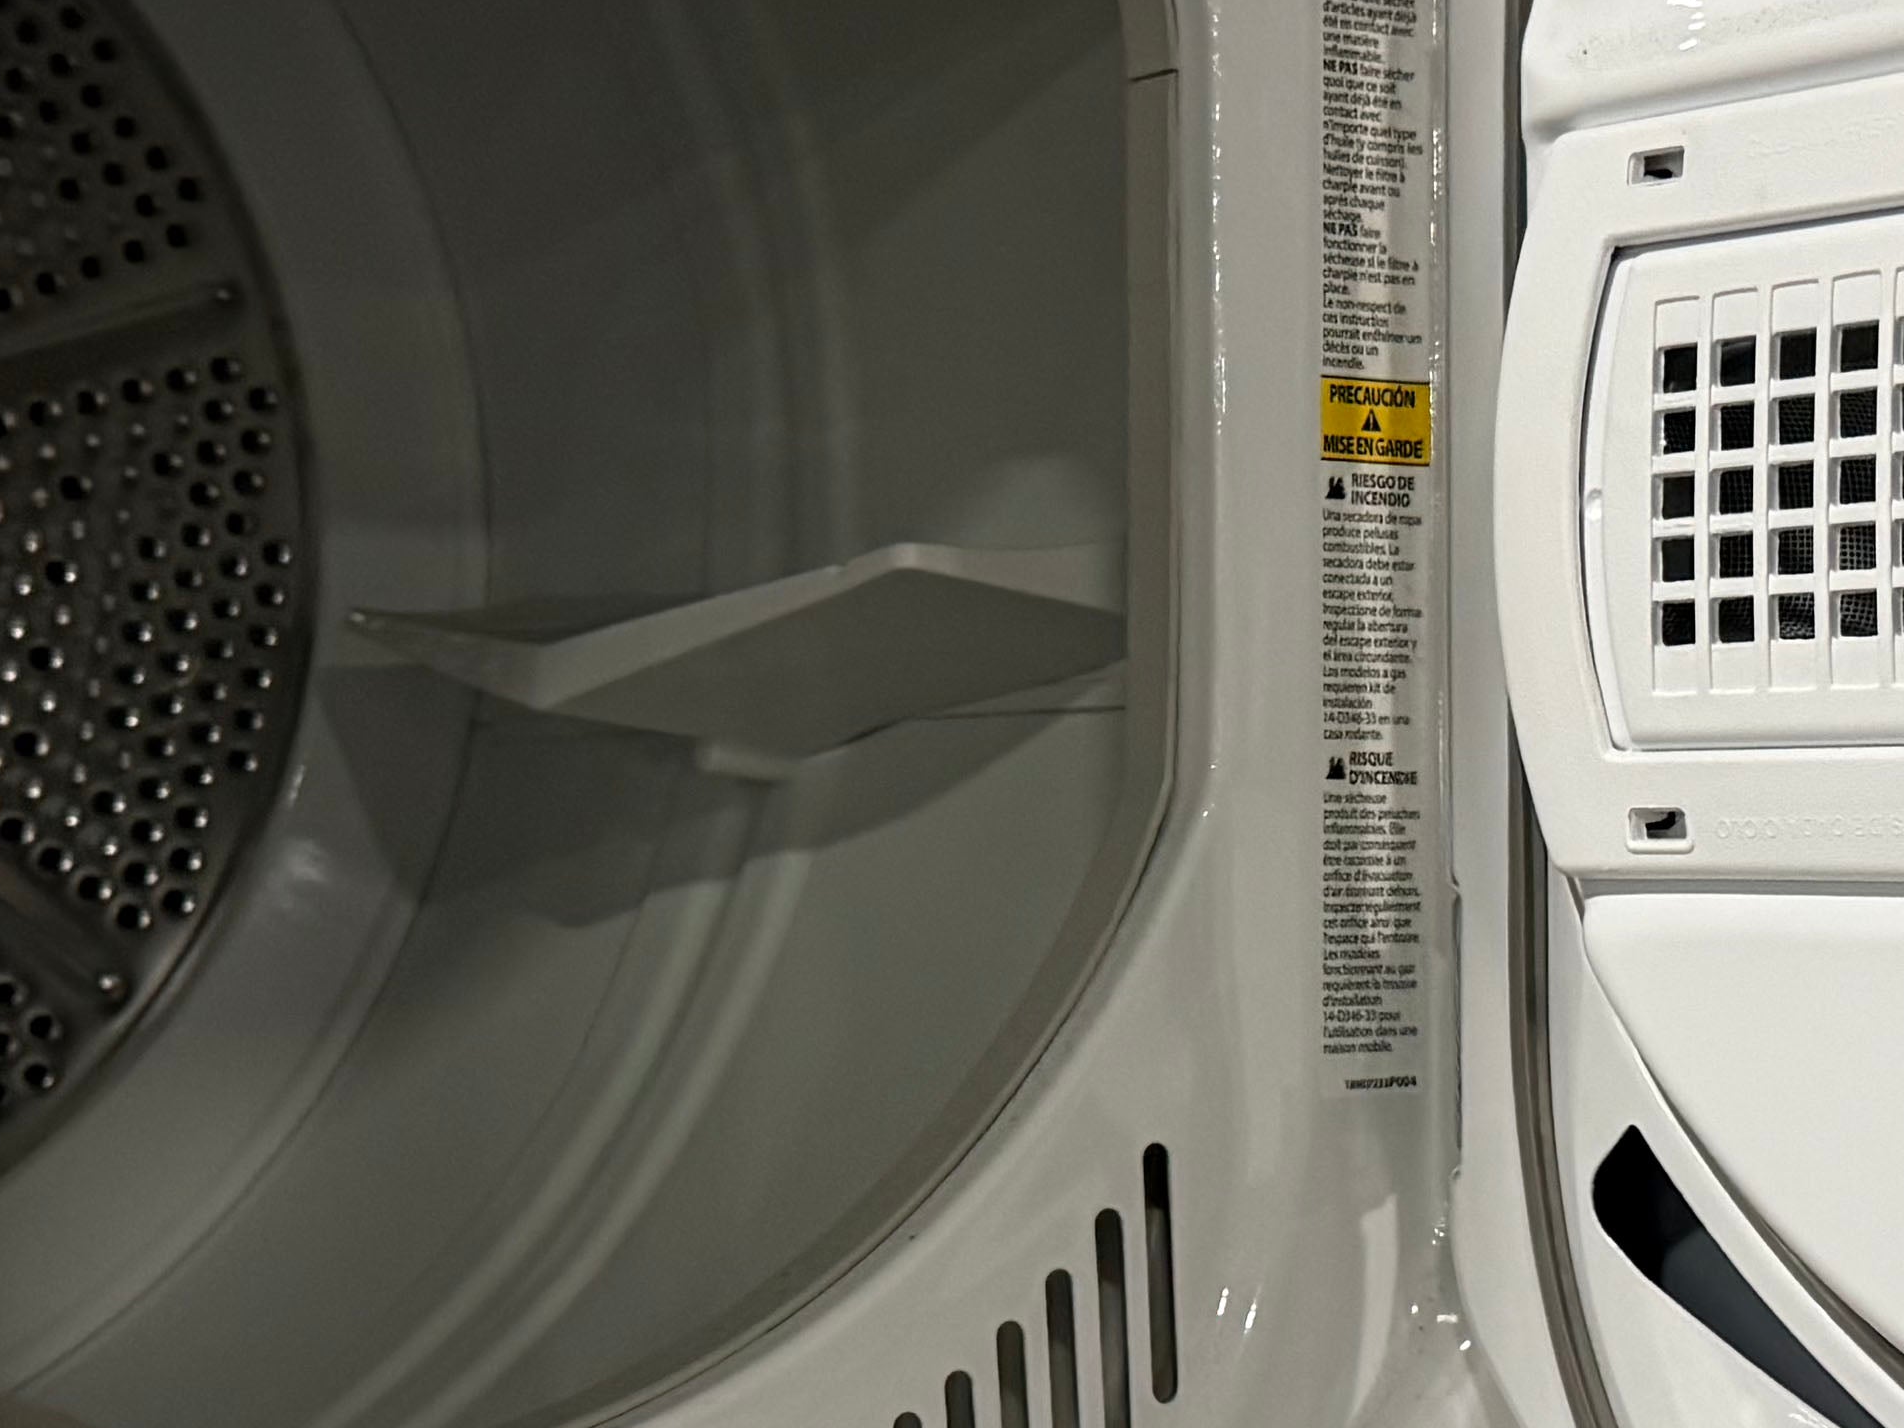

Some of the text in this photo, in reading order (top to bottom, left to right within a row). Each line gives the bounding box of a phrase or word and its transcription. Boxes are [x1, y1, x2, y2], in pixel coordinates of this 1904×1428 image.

[1329, 384, 1415, 408] PRECAUCIÓN
[1323, 436, 1423, 459] MISE EN GARDE
